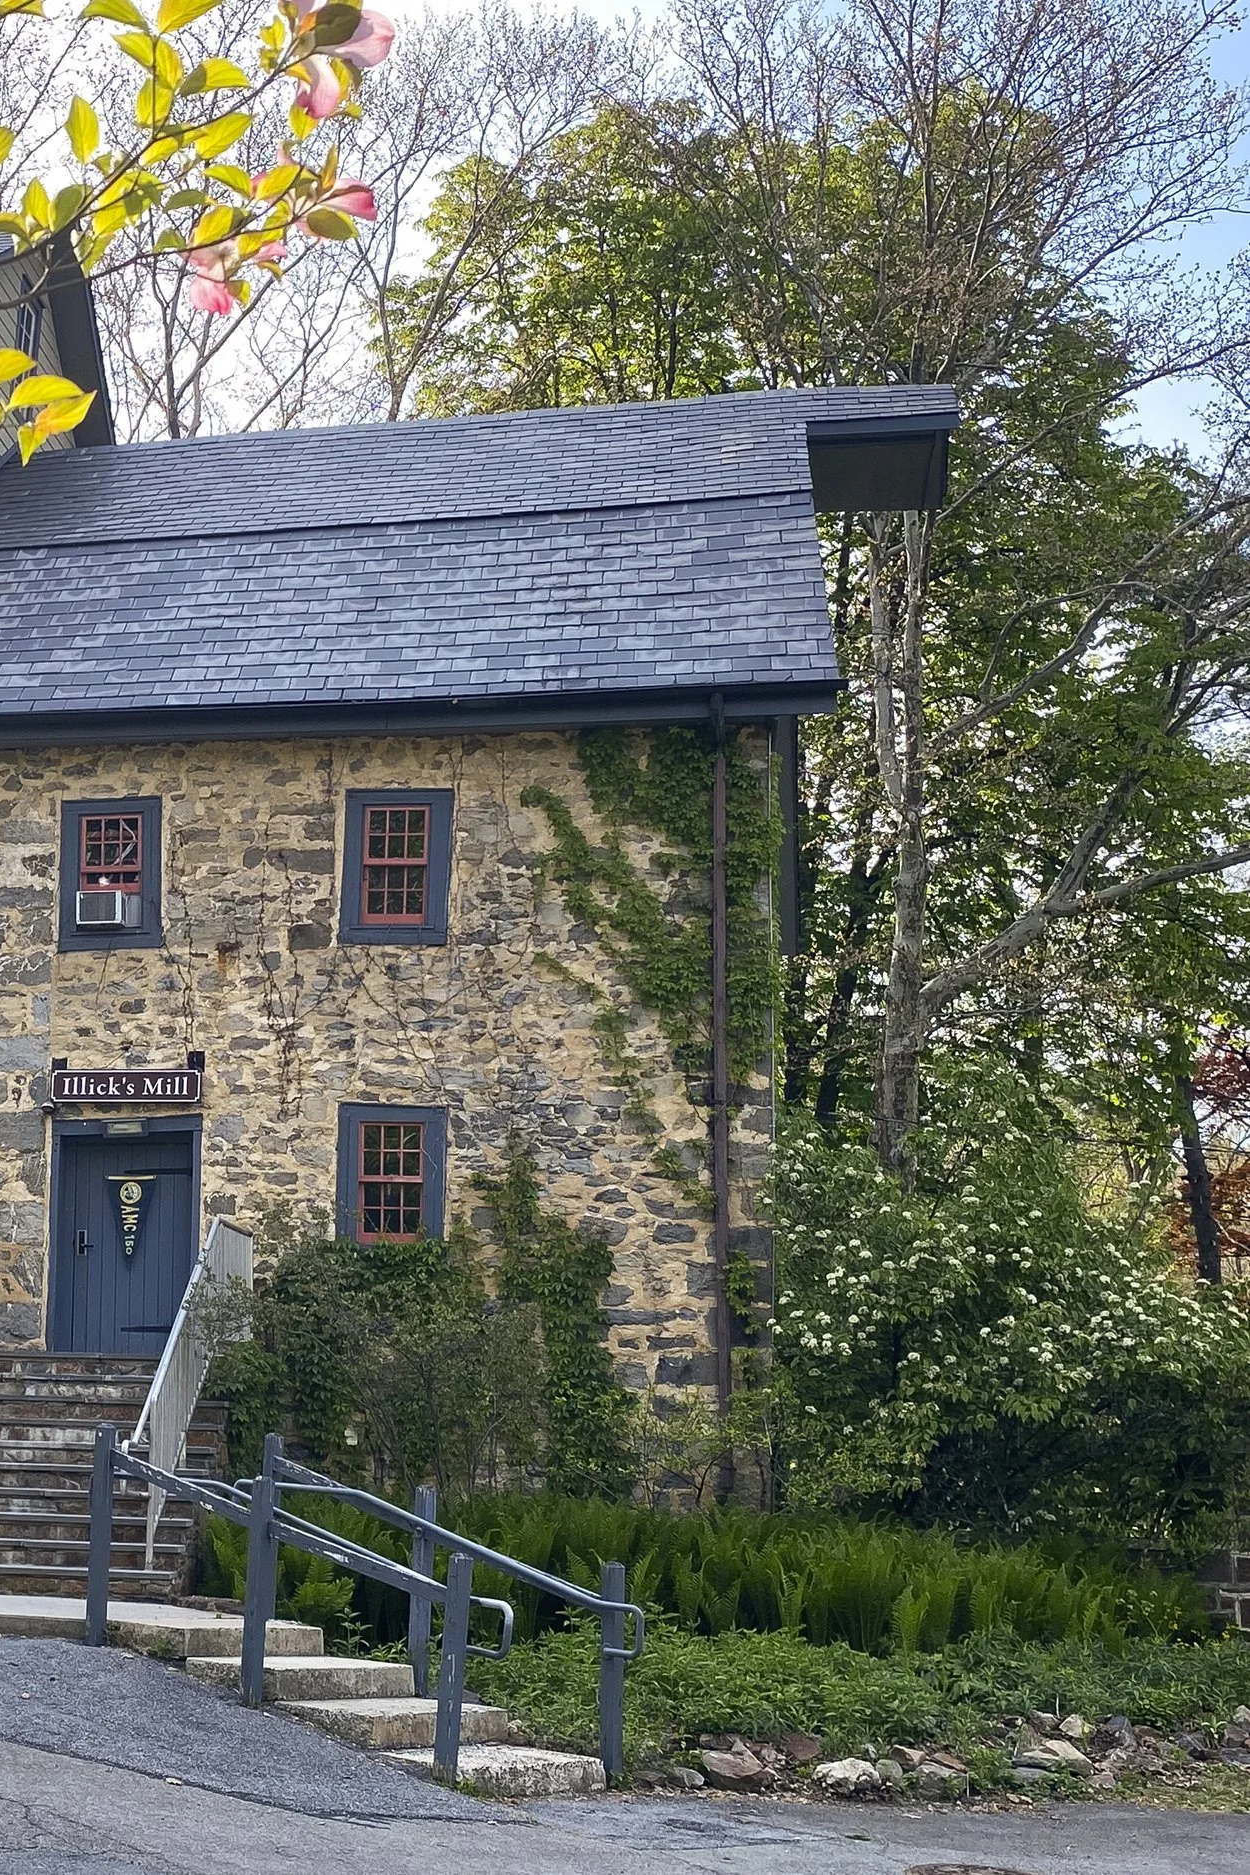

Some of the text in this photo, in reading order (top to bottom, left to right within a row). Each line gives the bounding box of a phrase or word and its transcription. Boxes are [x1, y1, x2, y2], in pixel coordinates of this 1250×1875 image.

[62, 1076, 189, 1096] Illick's Mill
[120, 1205, 140, 1232] AMC
[124, 1235, 135, 1255] 150
